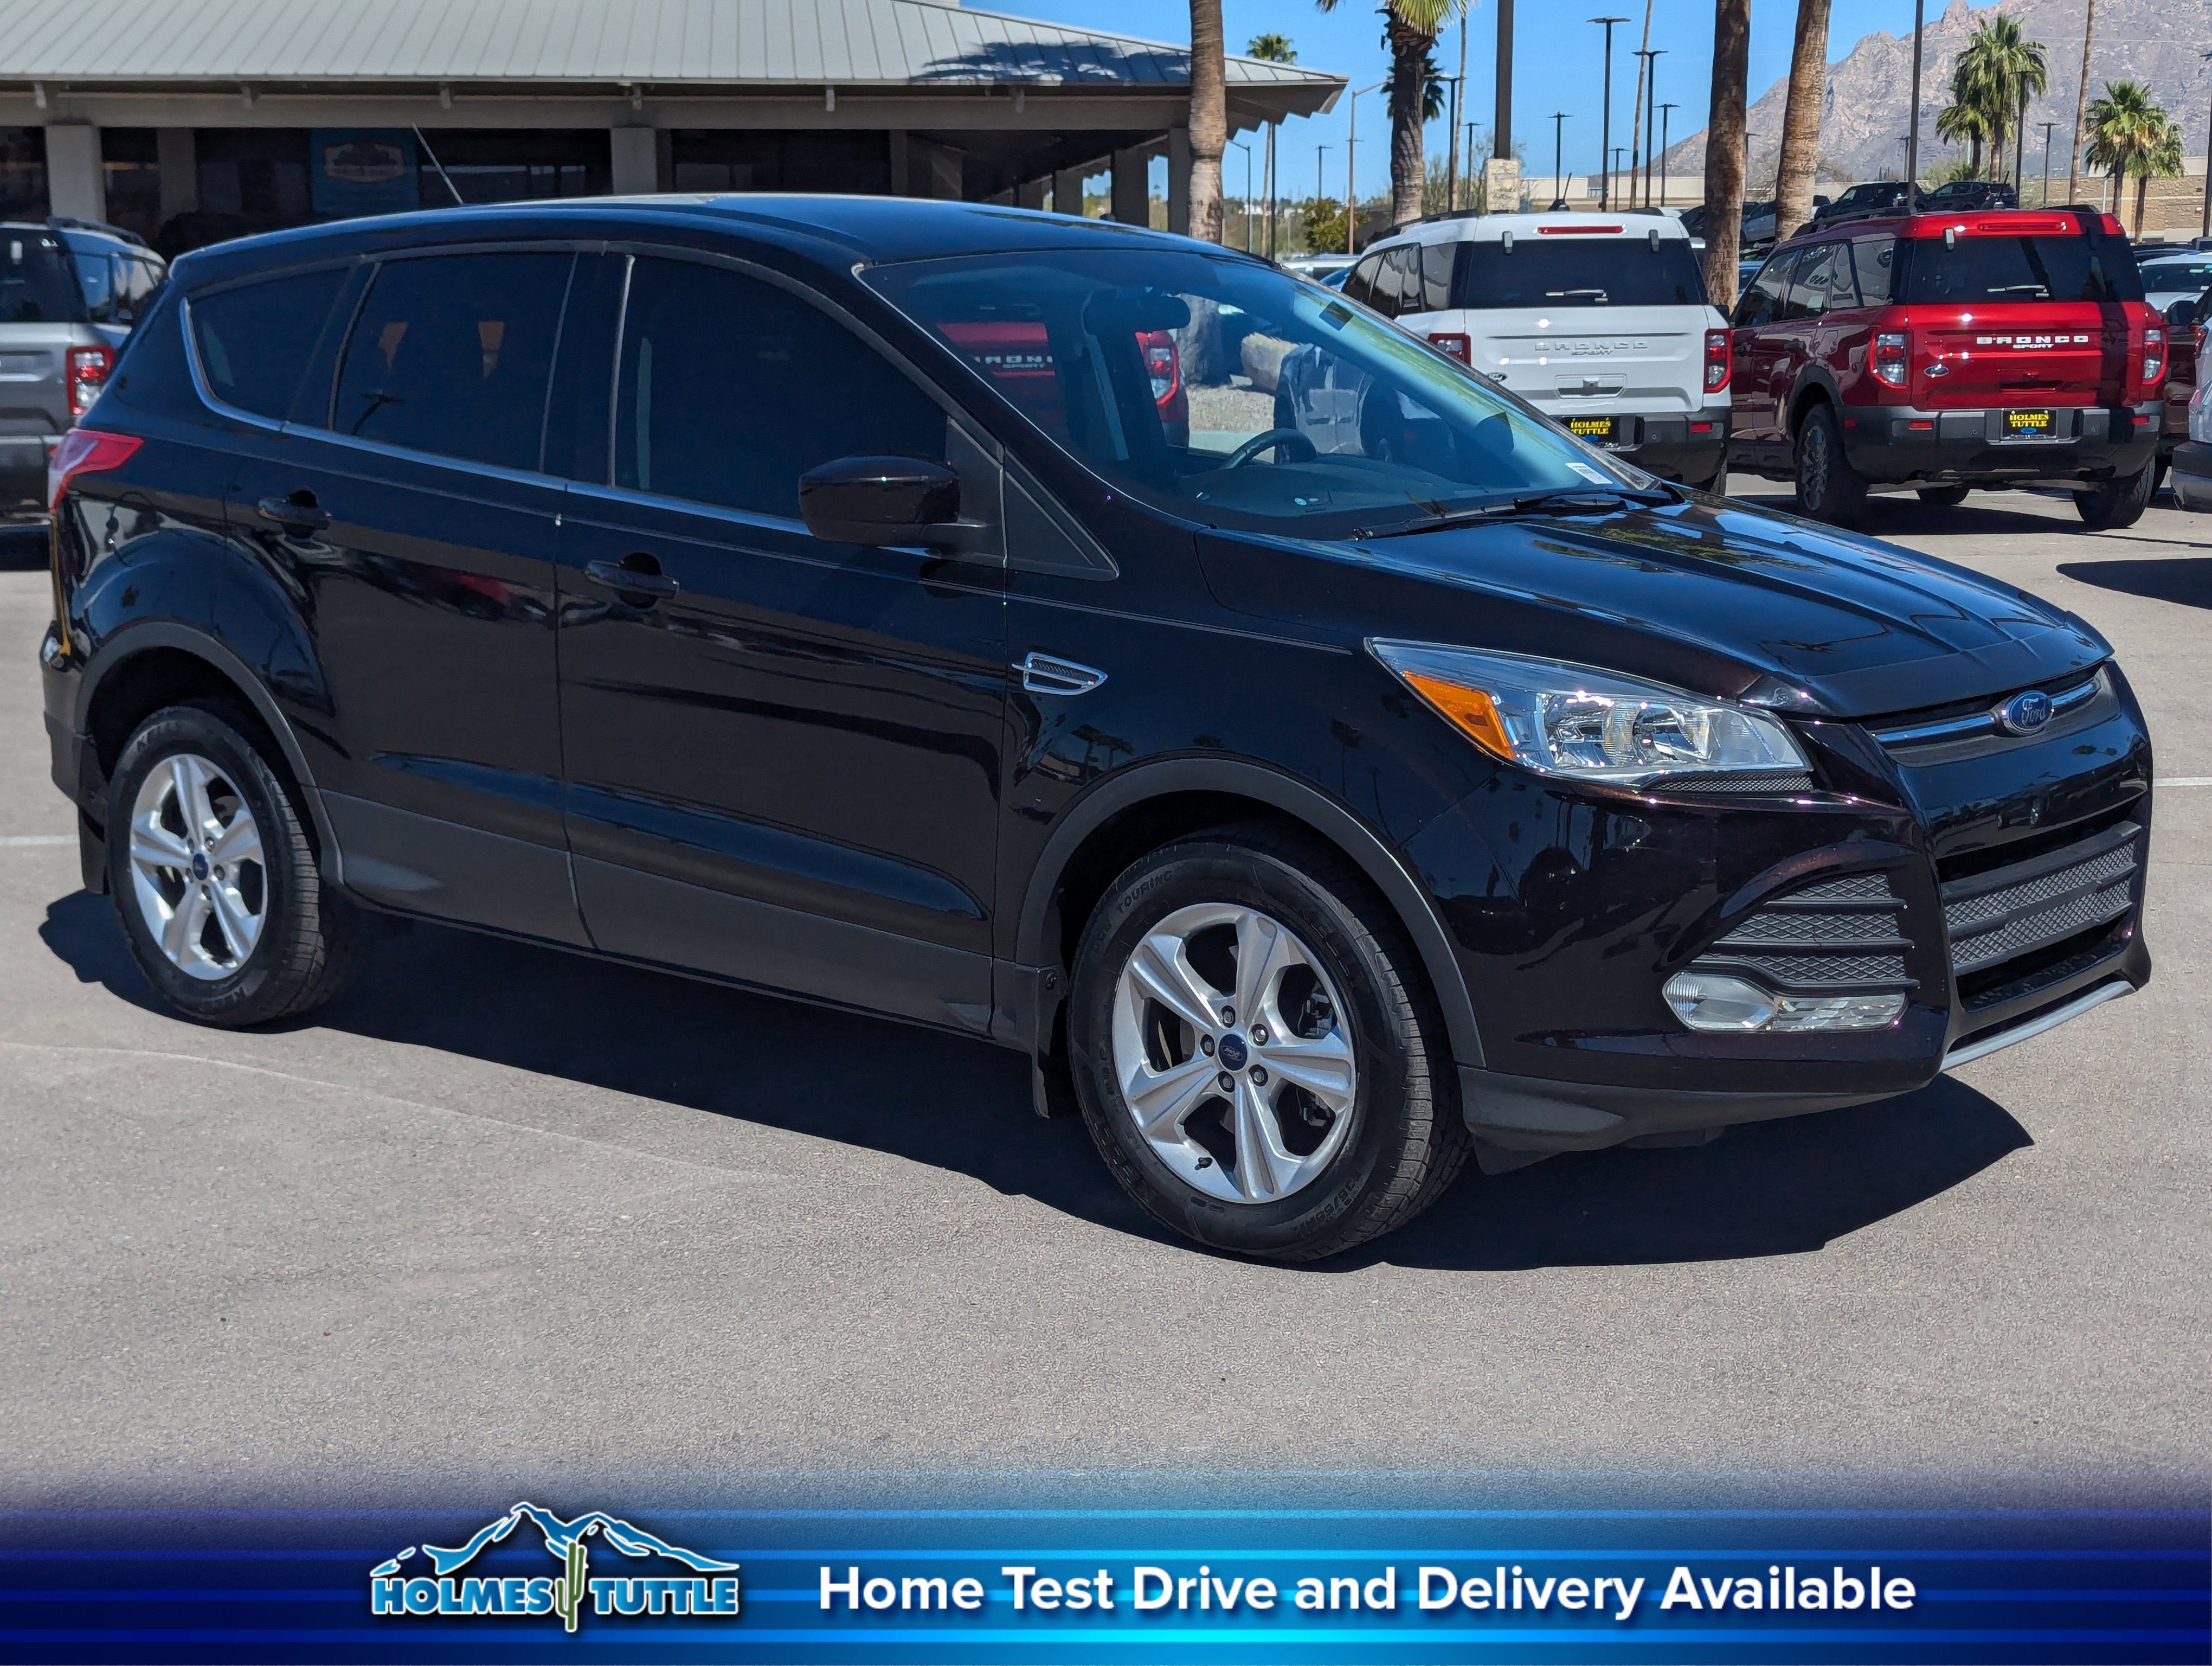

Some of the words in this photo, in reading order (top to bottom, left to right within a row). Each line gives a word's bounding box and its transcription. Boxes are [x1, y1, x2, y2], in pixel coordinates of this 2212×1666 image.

[1535, 341, 1648, 351] BRONCO
[1976, 335, 2088, 344] BRONCO
[2021, 697, 2047, 727] Ford
[1117, 870, 1173, 913] TOURING
